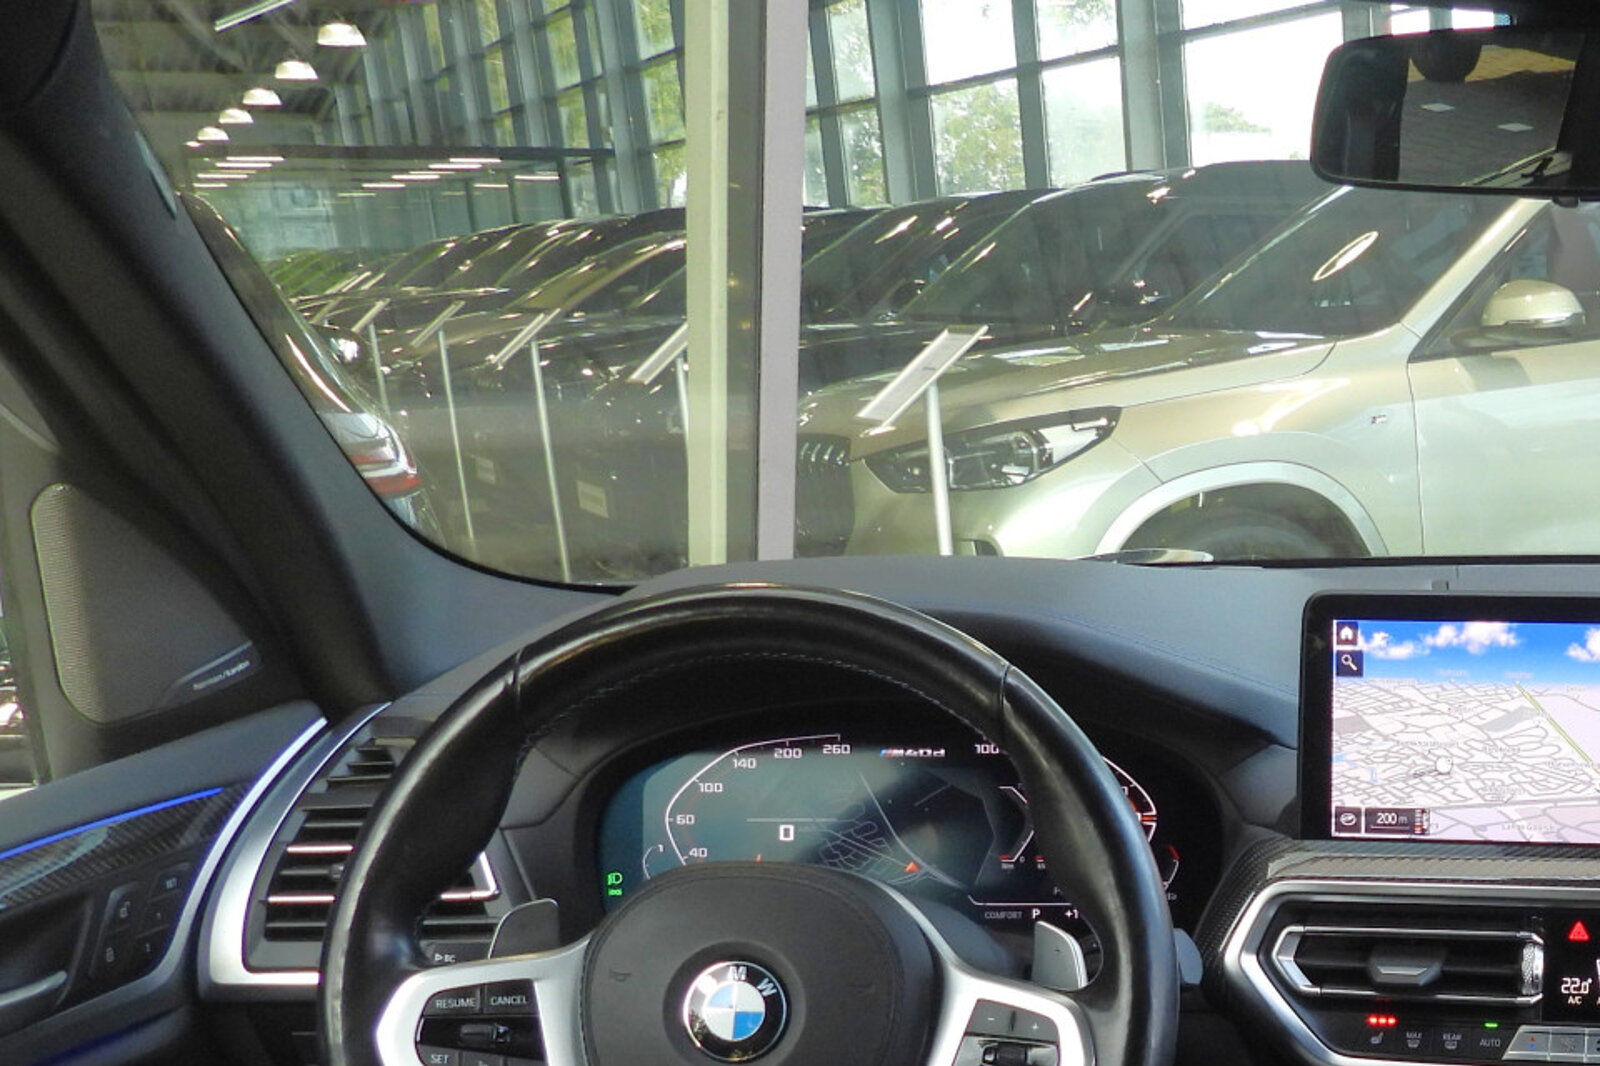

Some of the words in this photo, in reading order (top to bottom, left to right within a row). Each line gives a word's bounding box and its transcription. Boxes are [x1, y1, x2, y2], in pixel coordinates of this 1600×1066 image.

[774, 748, 803, 759] 200
[823, 744, 851, 755] 260
[733, 758, 757, 769] 140
[699, 782, 724, 793] 100
[676, 814, 696, 825] 60
[1376, 813, 1398, 826] 200
[779, 824, 795, 842] 0
[689, 847, 708, 858] 40
[1031, 908, 1041, 919] P
[435, 997, 477, 1010] RESUME
[489, 993, 529, 1007] CANCEL
[1567, 996, 1582, 1005] A/C
[1479, 1038, 1501, 1048] AUTO
[430, 1053, 450, 1065] SET
